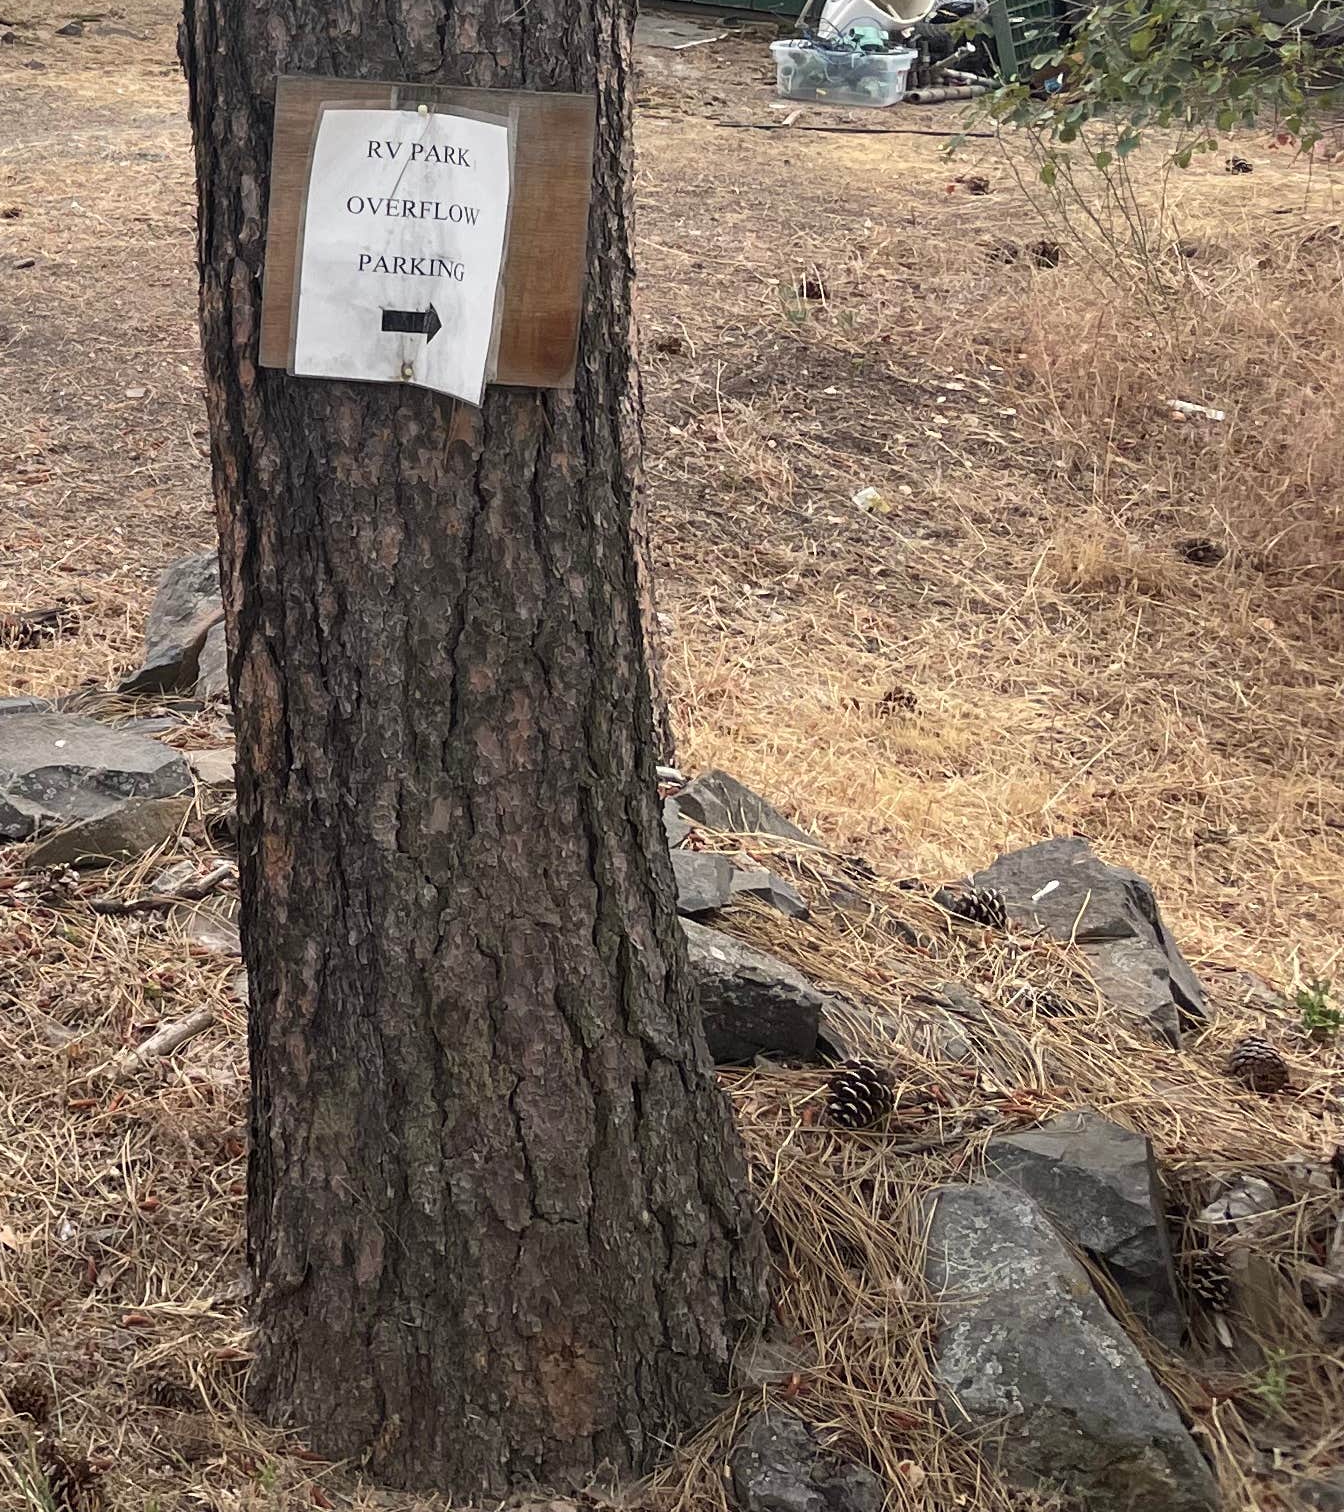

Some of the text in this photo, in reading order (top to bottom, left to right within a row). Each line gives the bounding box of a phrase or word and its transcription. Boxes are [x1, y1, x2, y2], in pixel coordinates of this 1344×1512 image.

[367, 140, 471, 167] RV PARK
[346, 195, 480, 226] OVERFLOW
[358, 253, 465, 282] PARKING
